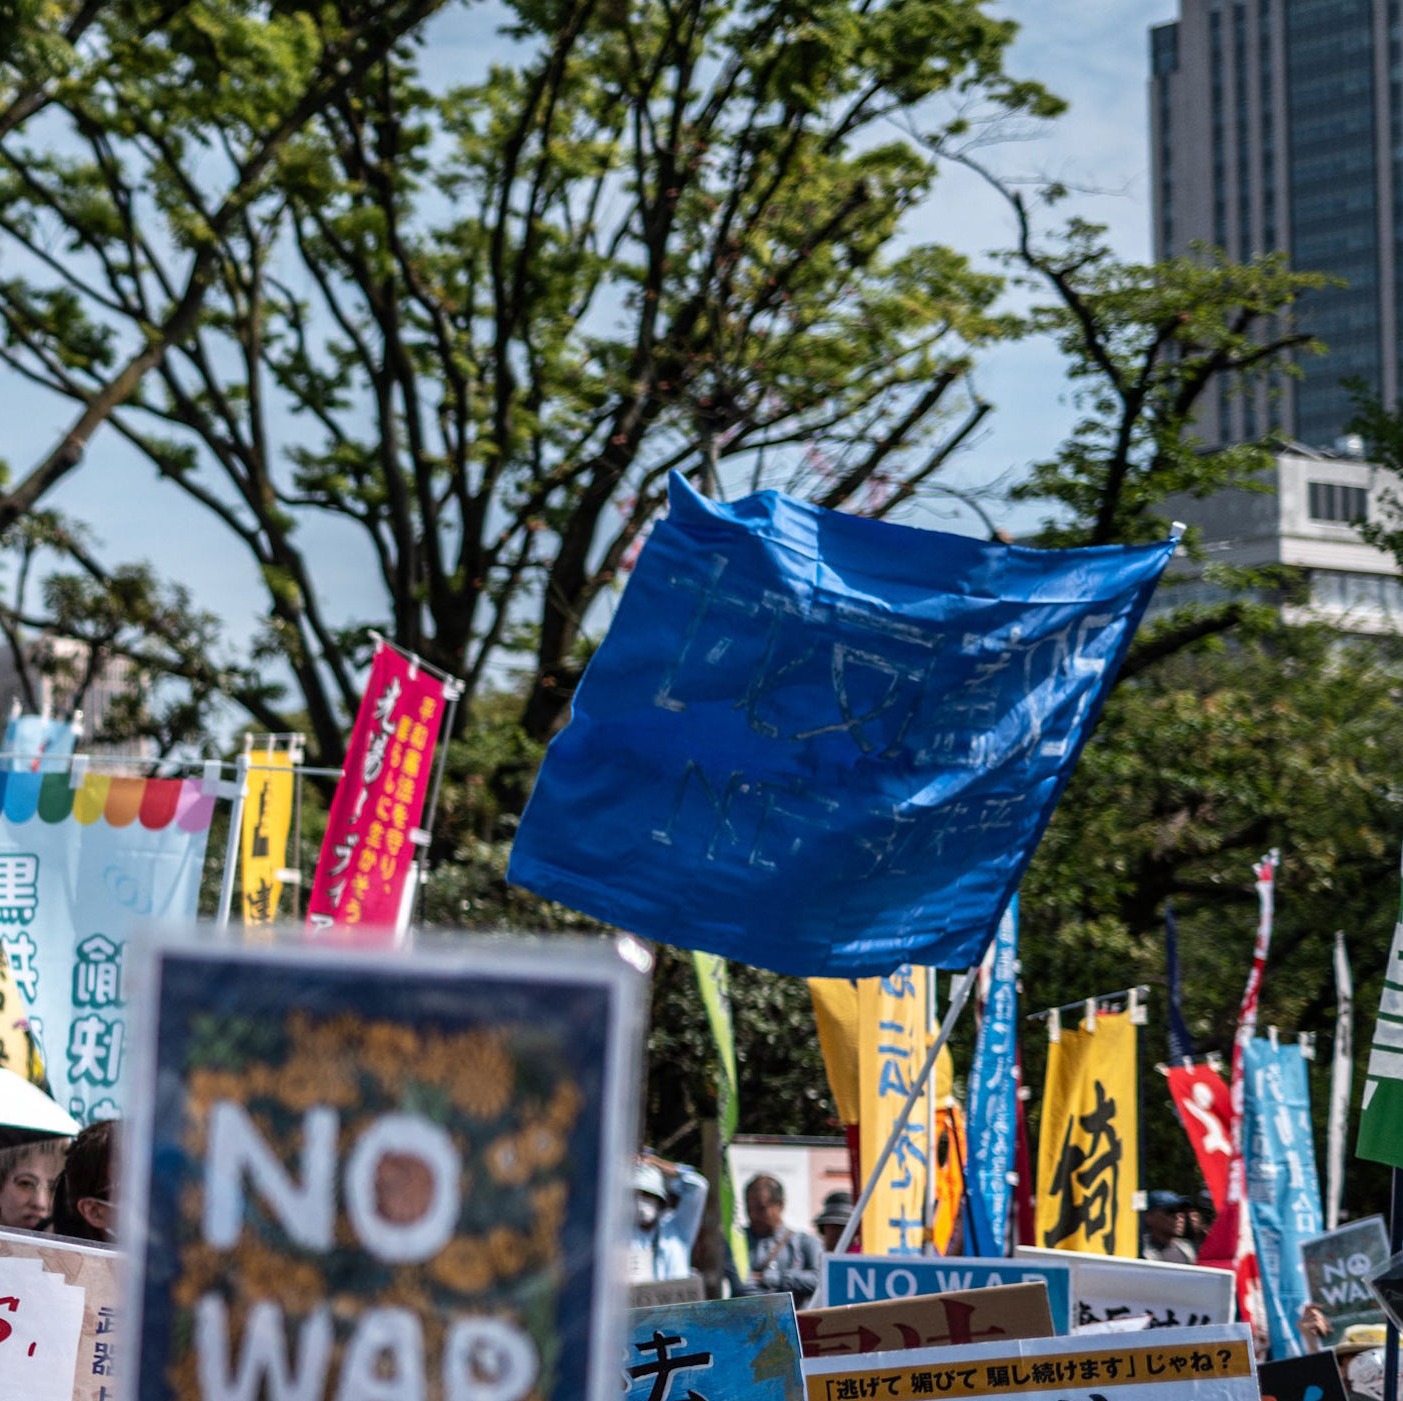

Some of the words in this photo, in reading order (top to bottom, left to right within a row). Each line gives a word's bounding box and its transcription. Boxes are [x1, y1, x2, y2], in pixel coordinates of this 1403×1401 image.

[201, 1102, 462, 1263] NO
[847, 1267, 918, 1300] NO
[1322, 1252, 1371, 1284] NO
[825, 1375, 902, 1401] 「逃げて
[911, 1368, 978, 1393] 媚びて
